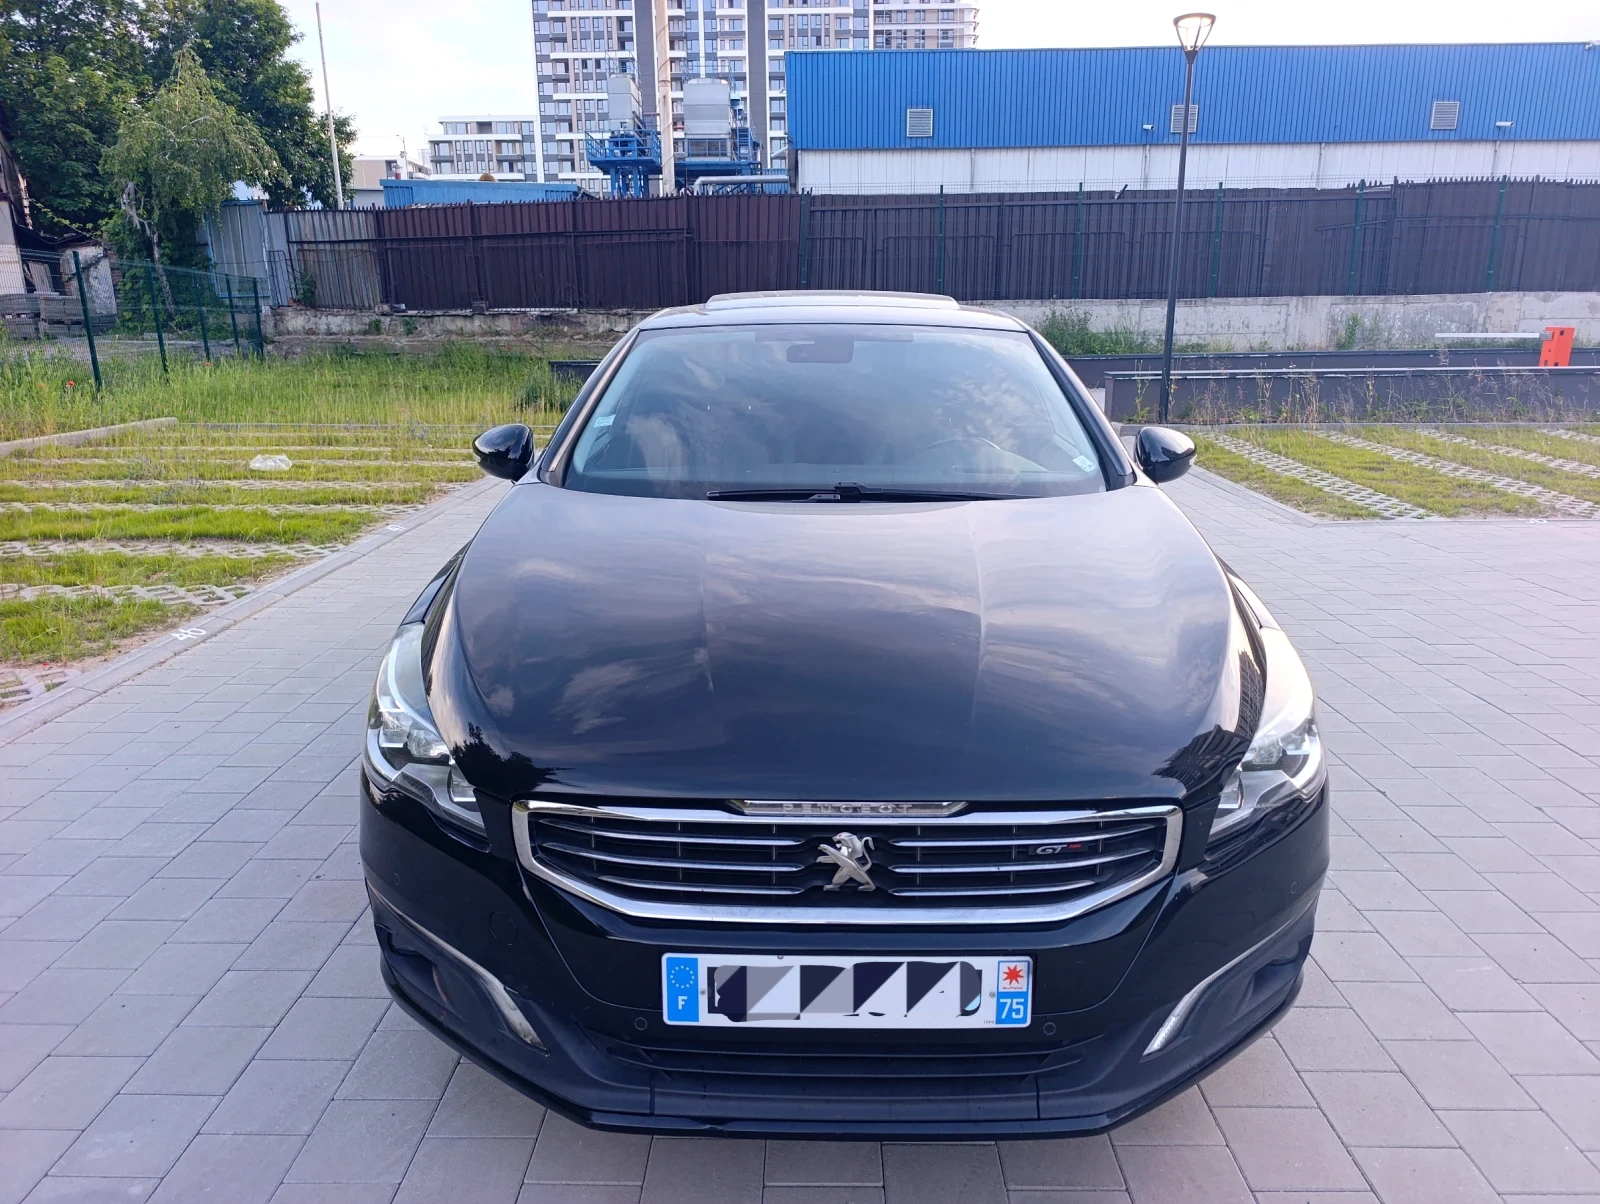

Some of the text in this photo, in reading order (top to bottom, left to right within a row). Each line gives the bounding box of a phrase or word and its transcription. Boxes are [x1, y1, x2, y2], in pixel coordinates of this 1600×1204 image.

[171, 628, 207, 641] 46
[782, 802, 913, 814] PEUGEOT
[1036, 844, 1068, 855] GT
[677, 995, 688, 1010] F
[999, 998, 1025, 1019] 75
